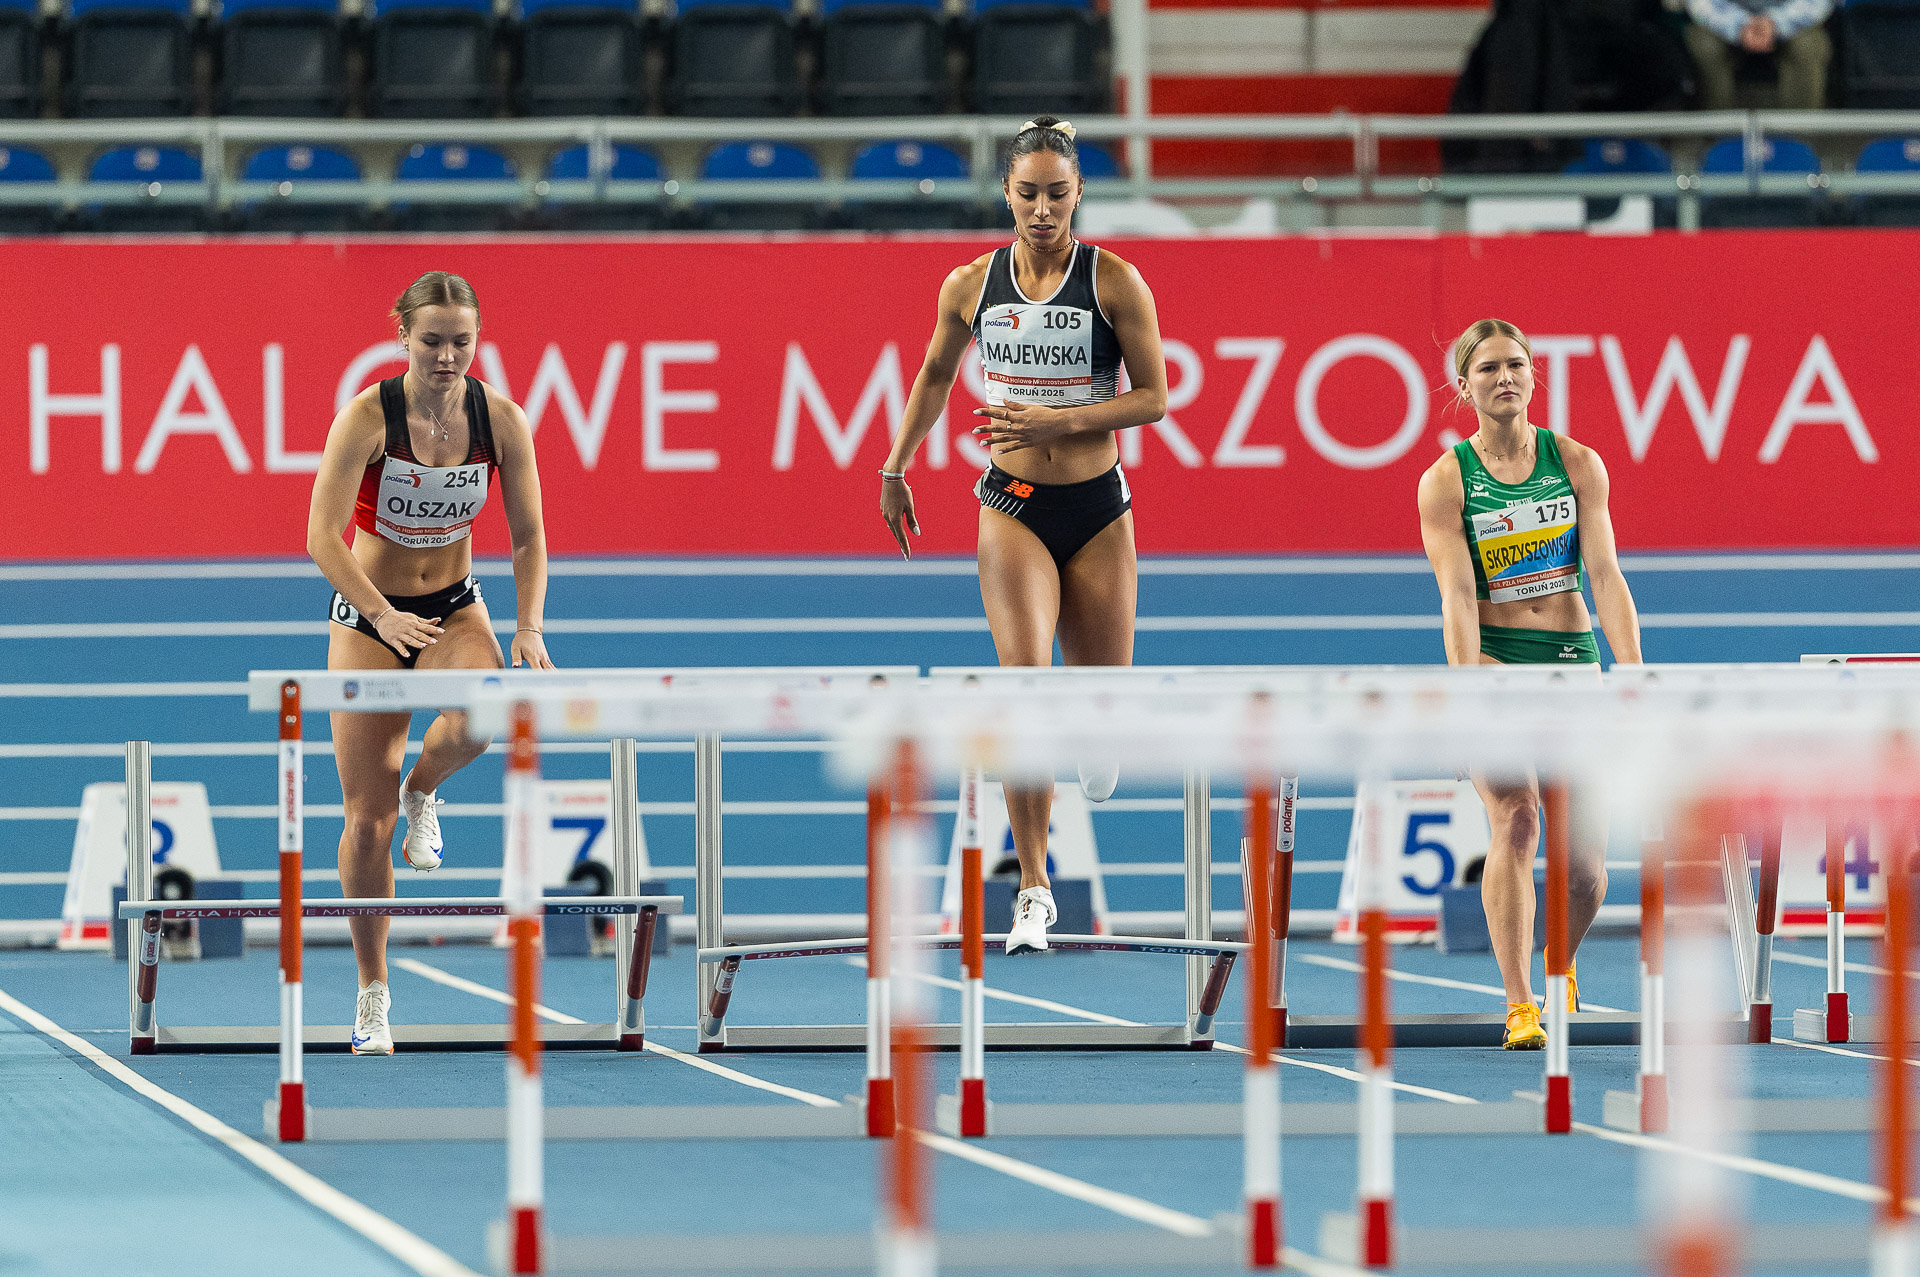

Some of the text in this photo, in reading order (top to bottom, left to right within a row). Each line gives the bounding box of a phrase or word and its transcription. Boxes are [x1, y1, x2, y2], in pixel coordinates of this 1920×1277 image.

[984, 319, 1012, 328] polanik
[1042, 310, 1082, 330] 105
[986, 341, 1088, 366] MAJEWSKA
[1008, 386, 1065, 397] TORUŃ 2025
[27, 340, 721, 475] HALWE
[384, 474, 414, 486] polanik
[443, 469, 480, 489] 254
[387, 496, 477, 519] OLSZAK
[1535, 501, 1570, 524] 175
[397, 534, 452, 545] TORUŃ 2025
[1480, 525, 1507, 537] polanik
[1485, 534, 1575, 570] SKRZYSZOWSKA
[1515, 579, 1566, 596] TORUŃ 2025
[1283, 795, 1294, 834] polanik
[551, 818, 606, 868] 7
[1402, 813, 1456, 896] 5
[175, 909, 221, 918] PZLA
[228, 907, 317, 917] HALOE
[322, 905, 460, 916] MISTRZOSTWA
[557, 904, 624, 914] TORUŃ
[757, 951, 803, 959] PZLA
[1050, 943, 1117, 951] POLSKI
